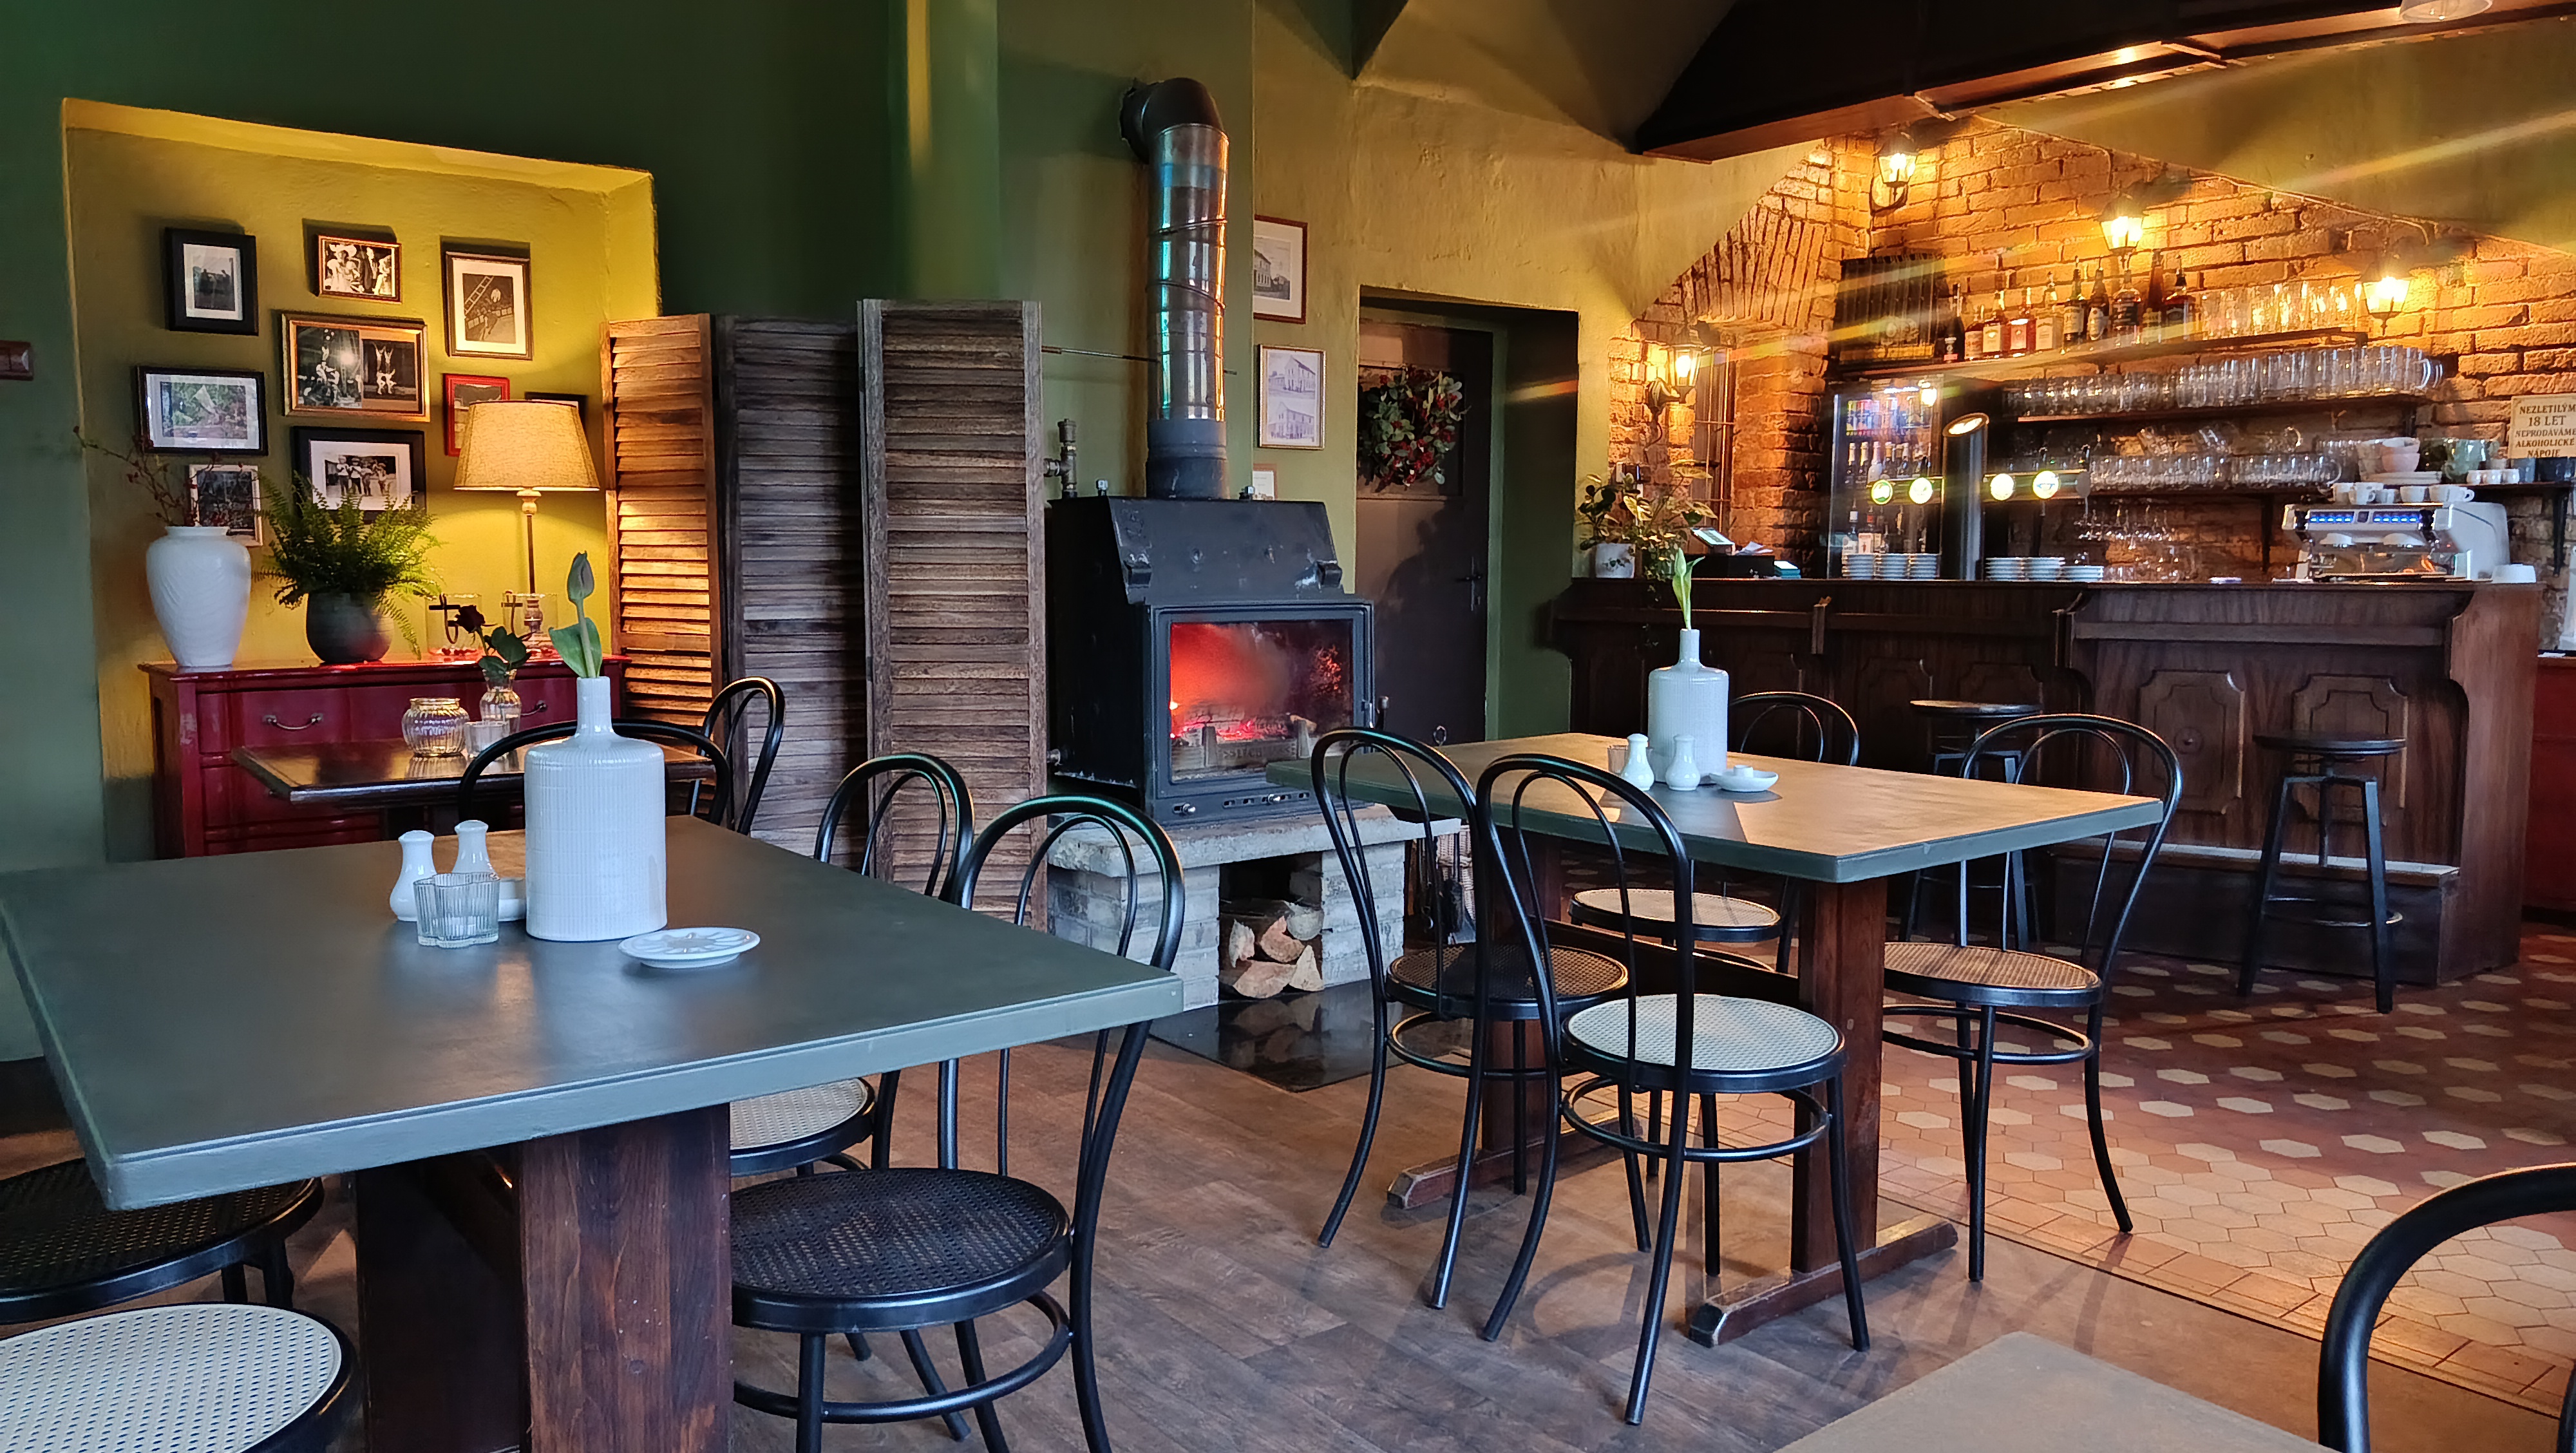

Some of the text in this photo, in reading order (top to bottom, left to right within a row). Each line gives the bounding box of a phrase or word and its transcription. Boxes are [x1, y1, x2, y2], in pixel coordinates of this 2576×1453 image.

[2528, 415, 2566, 426] 18 LET
[2515, 437, 2575, 448] ALKOHOLICKÉ
